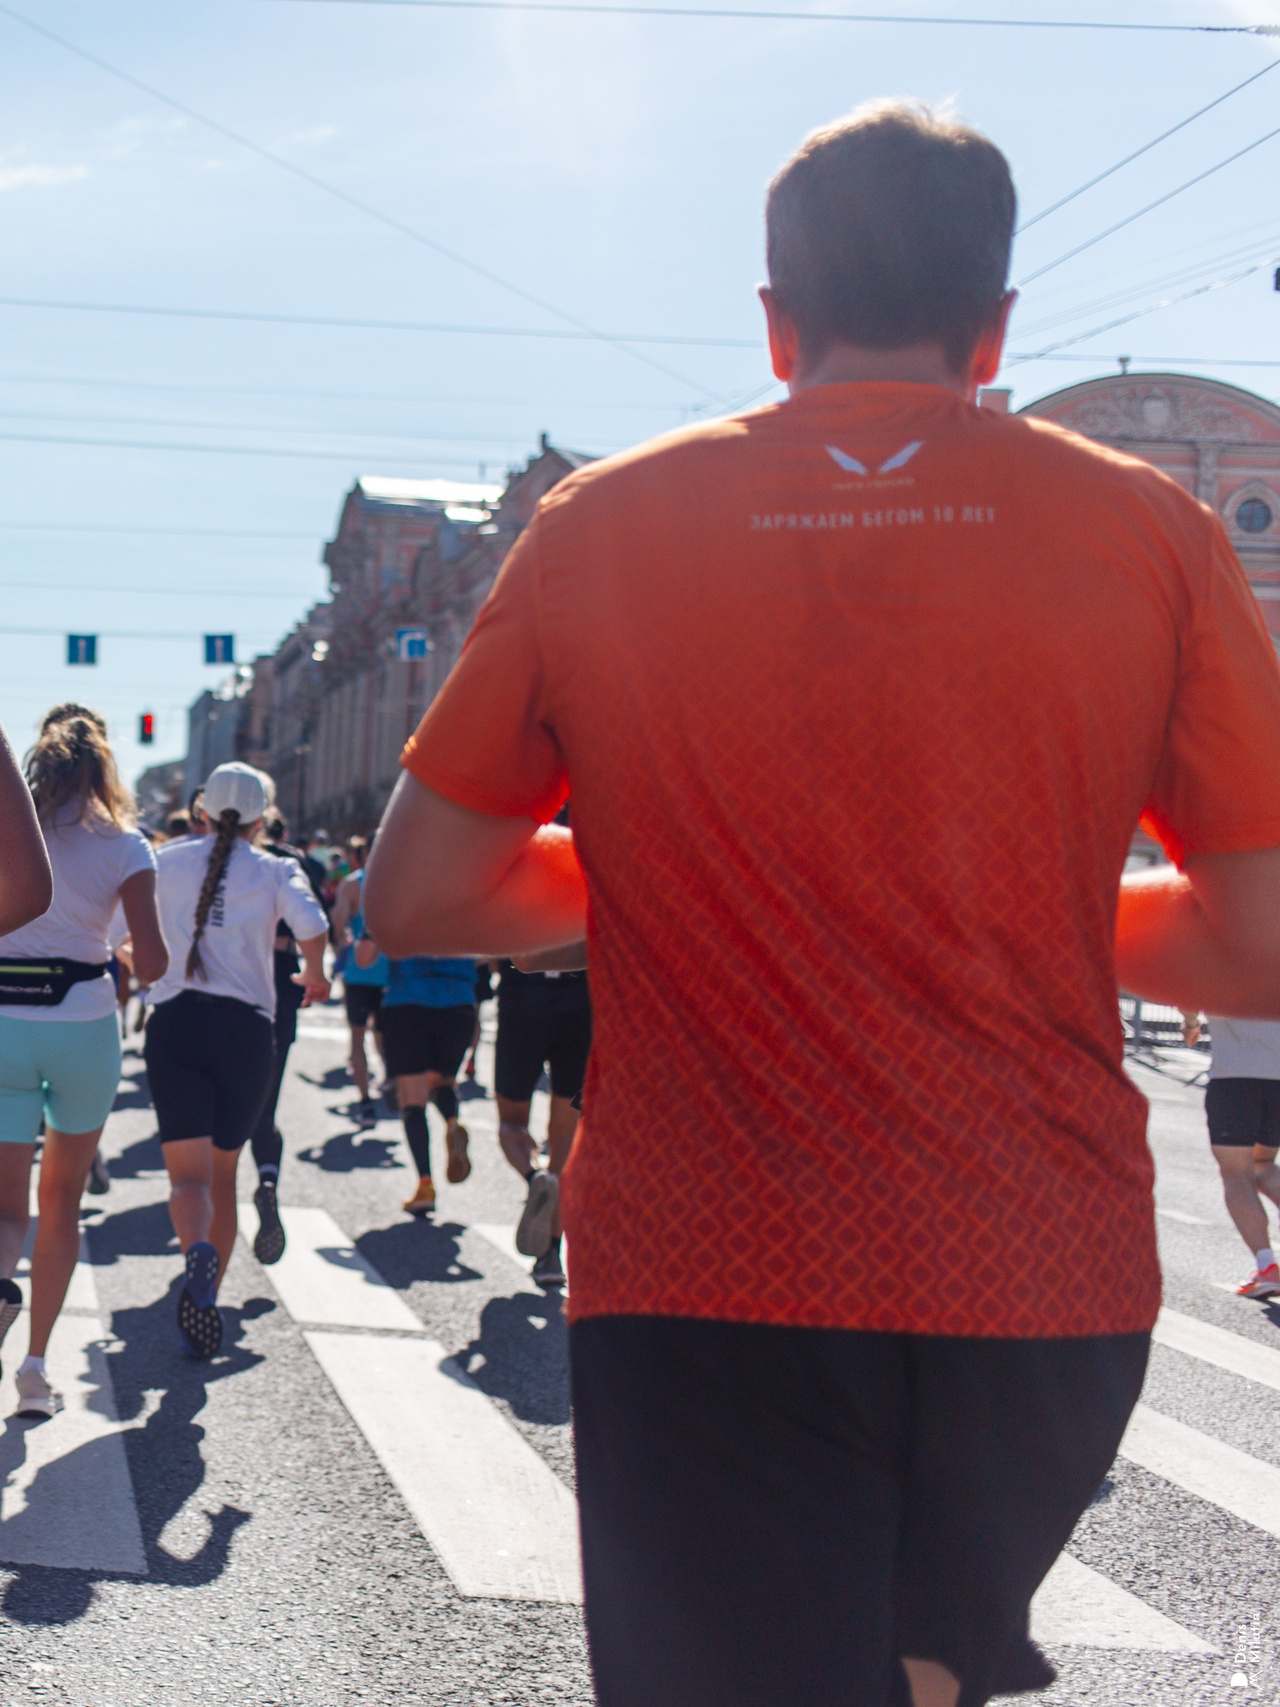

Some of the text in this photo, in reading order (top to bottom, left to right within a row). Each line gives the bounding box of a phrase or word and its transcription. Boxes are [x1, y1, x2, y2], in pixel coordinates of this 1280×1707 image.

[749, 511, 855, 530] ЗАРЯЖАЕМ
[862, 507, 924, 528] БЕГОМ
[962, 504, 995, 523] ЛЕТ
